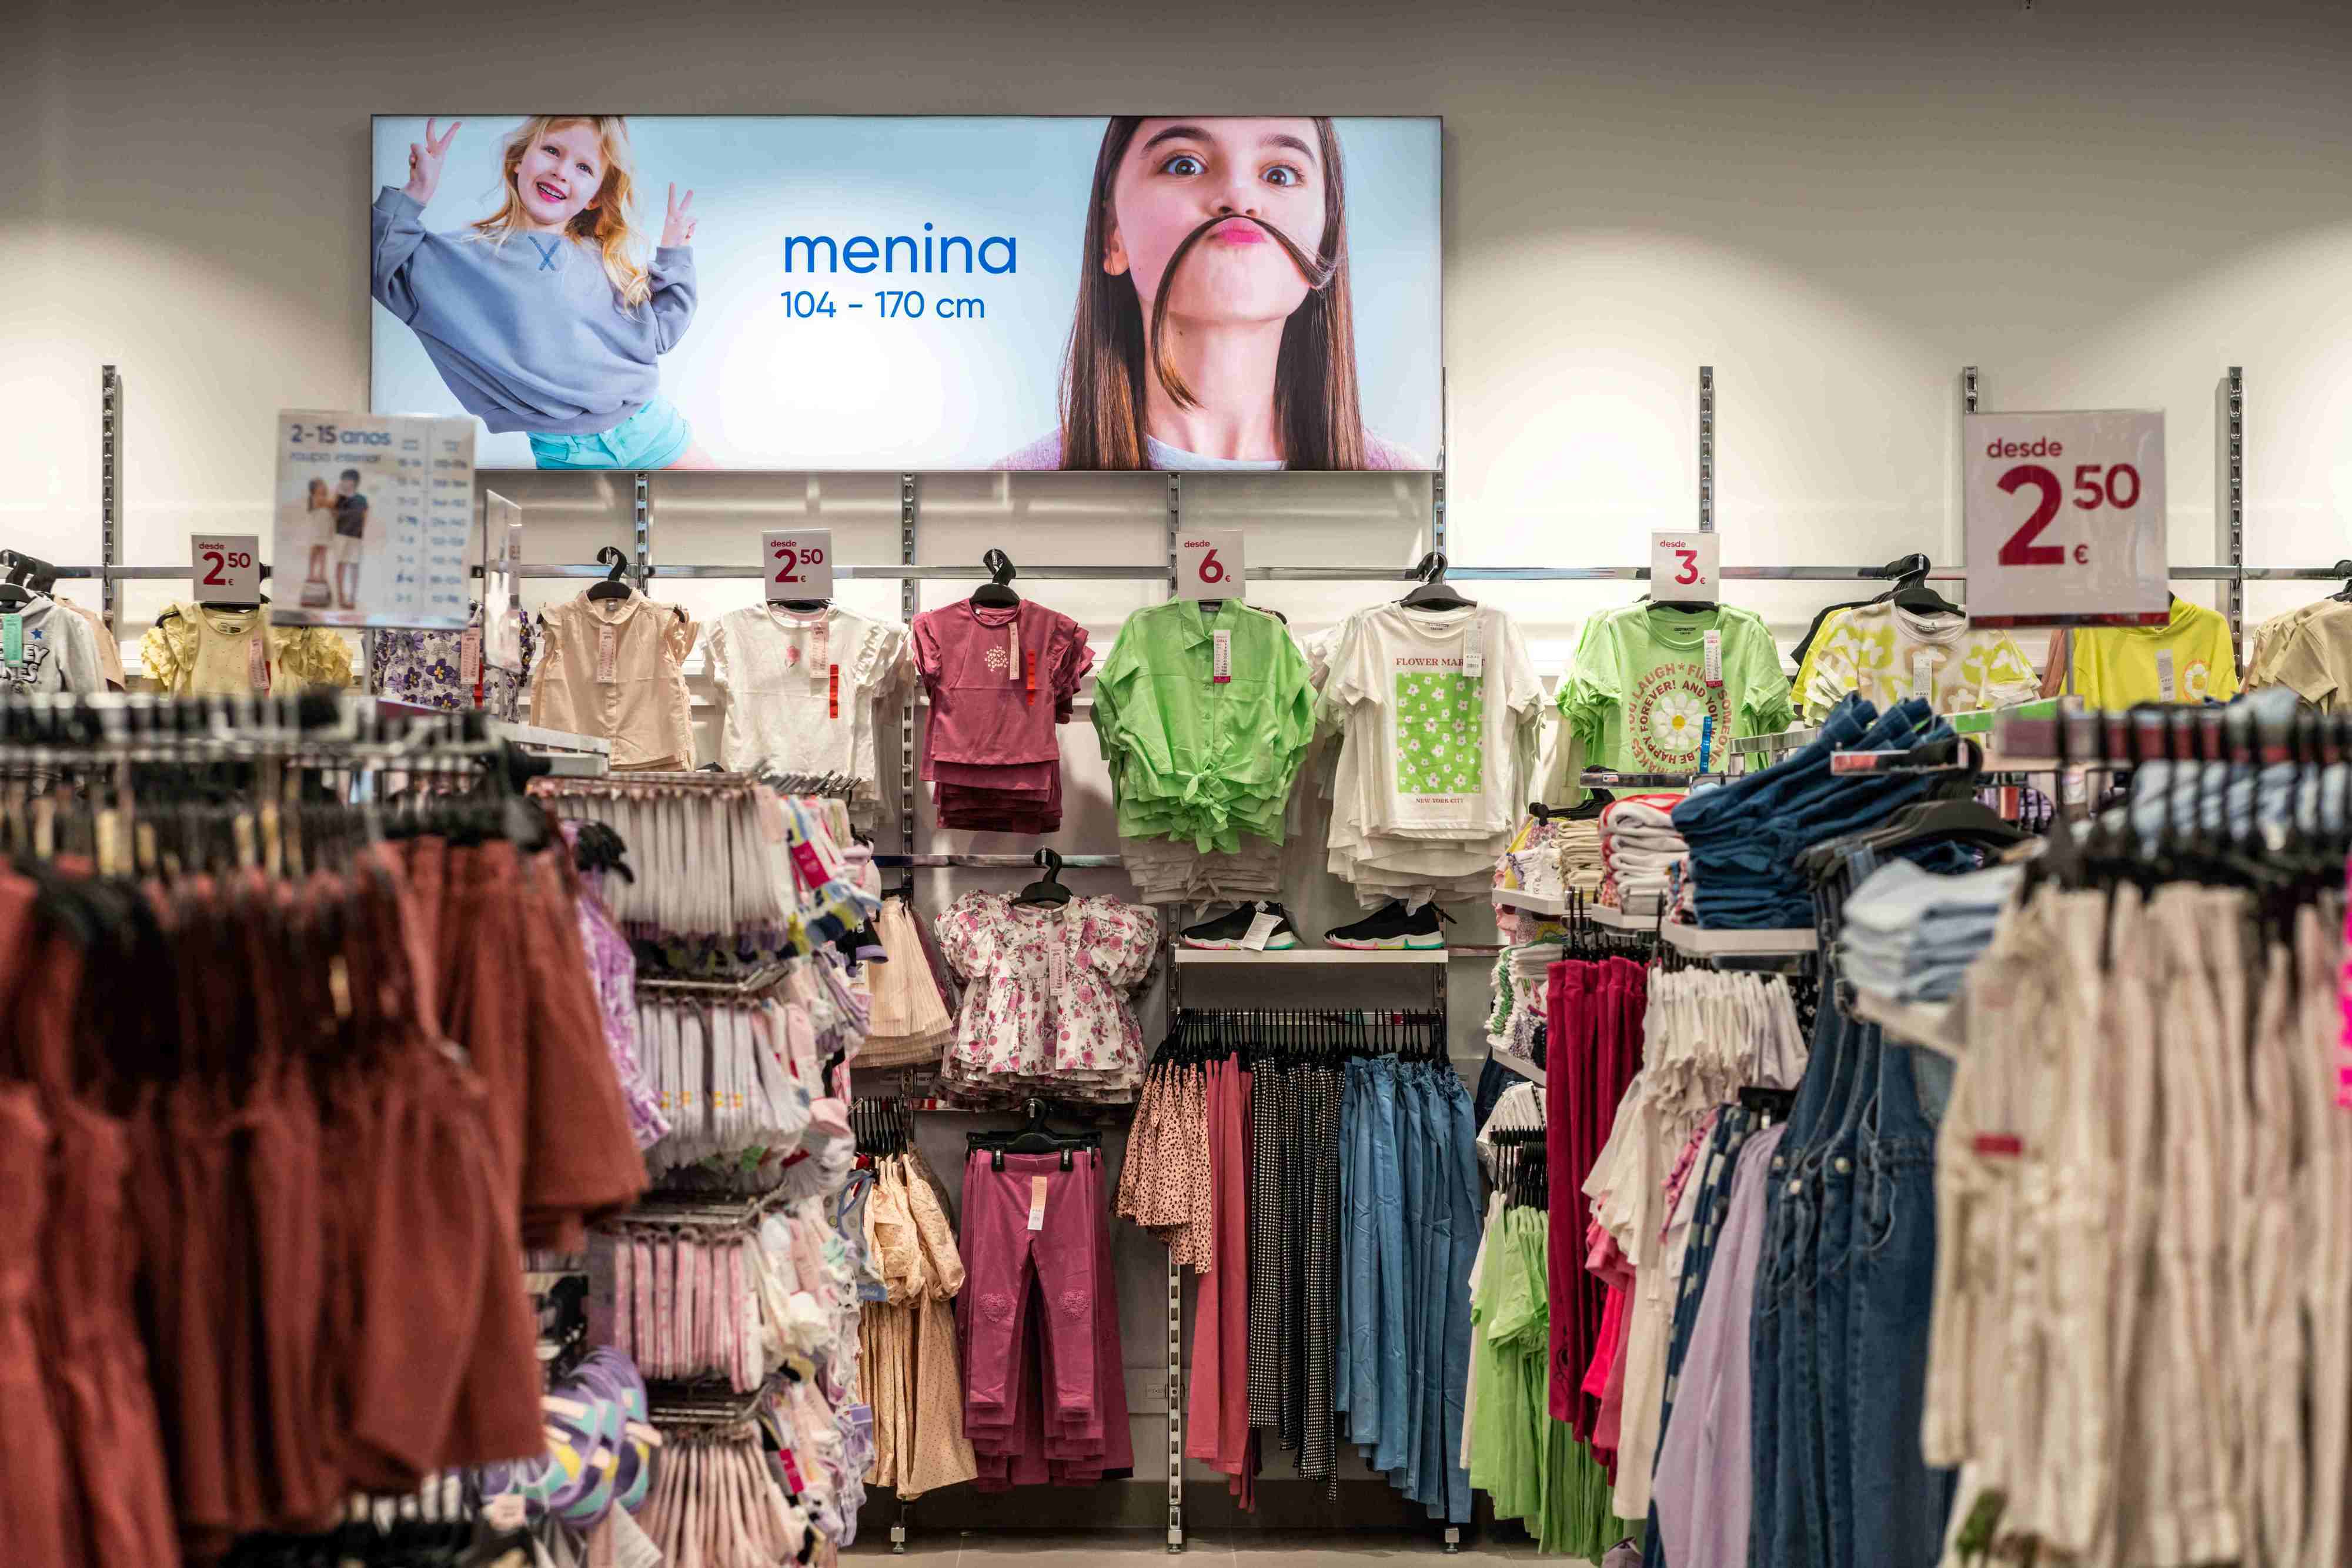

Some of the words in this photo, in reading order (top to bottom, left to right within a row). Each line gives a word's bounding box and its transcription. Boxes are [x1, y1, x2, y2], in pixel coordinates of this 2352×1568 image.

[784, 222, 1017, 275] menina
[780, 290, 837, 318] 104
[874, 290, 926, 318] 170
[936, 297, 985, 318] cm
[339, 431, 392, 445] anos
[1986, 436, 2063, 458] desde
[1996, 464, 2064, 566] 2
[2072, 463, 2141, 510] 50
[199, 541, 226, 550] desde
[771, 539, 797, 547] desde
[1184, 540, 1210, 548] desde
[1659, 540, 1686, 548] desde
[202, 551, 226, 585] 2
[228, 552, 251, 569] 50
[774, 549, 799, 583] 2
[800, 548, 824, 565] 50
[1199, 549, 1224, 584] 6
[1674, 550, 1698, 584] 3
[1396, 658, 1439, 666] FLOWER
[1441, 658, 1486, 667] MART
[1632, 663, 1676, 700] LAUGH
[1682, 680, 1706, 697] AND
[1639, 680, 1676, 733] FOREVER!
[1642, 735, 1676, 765] HAPPY
[1679, 751, 1695, 765] BE
